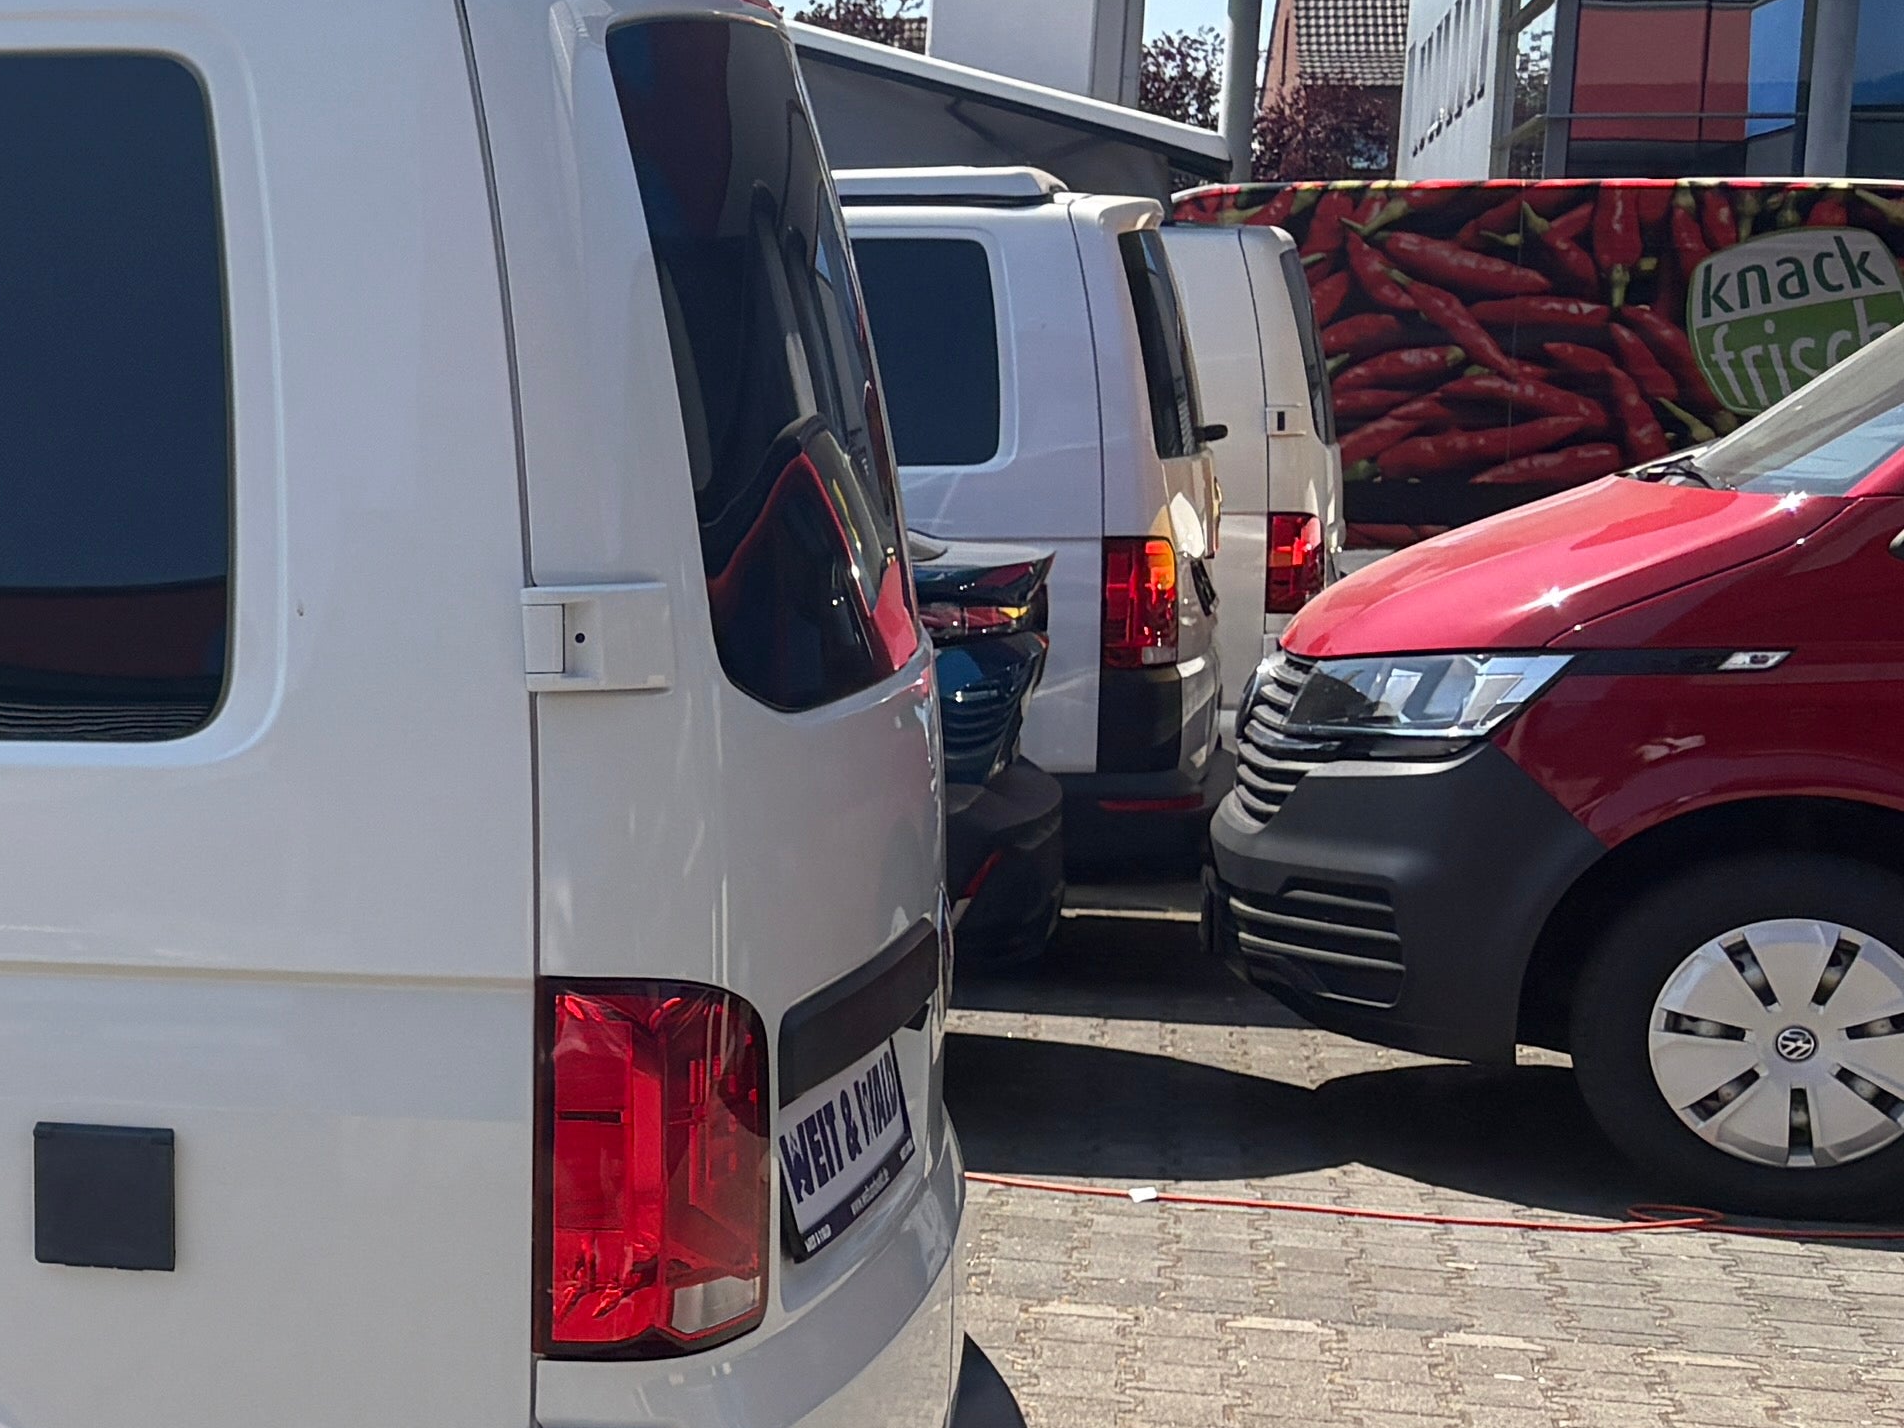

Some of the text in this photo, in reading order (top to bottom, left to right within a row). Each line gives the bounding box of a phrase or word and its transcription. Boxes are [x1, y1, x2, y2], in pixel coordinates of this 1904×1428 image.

[1701, 235, 1886, 319] knack
[779, 1100, 844, 1205] WEIT
[840, 1089, 863, 1162] &
